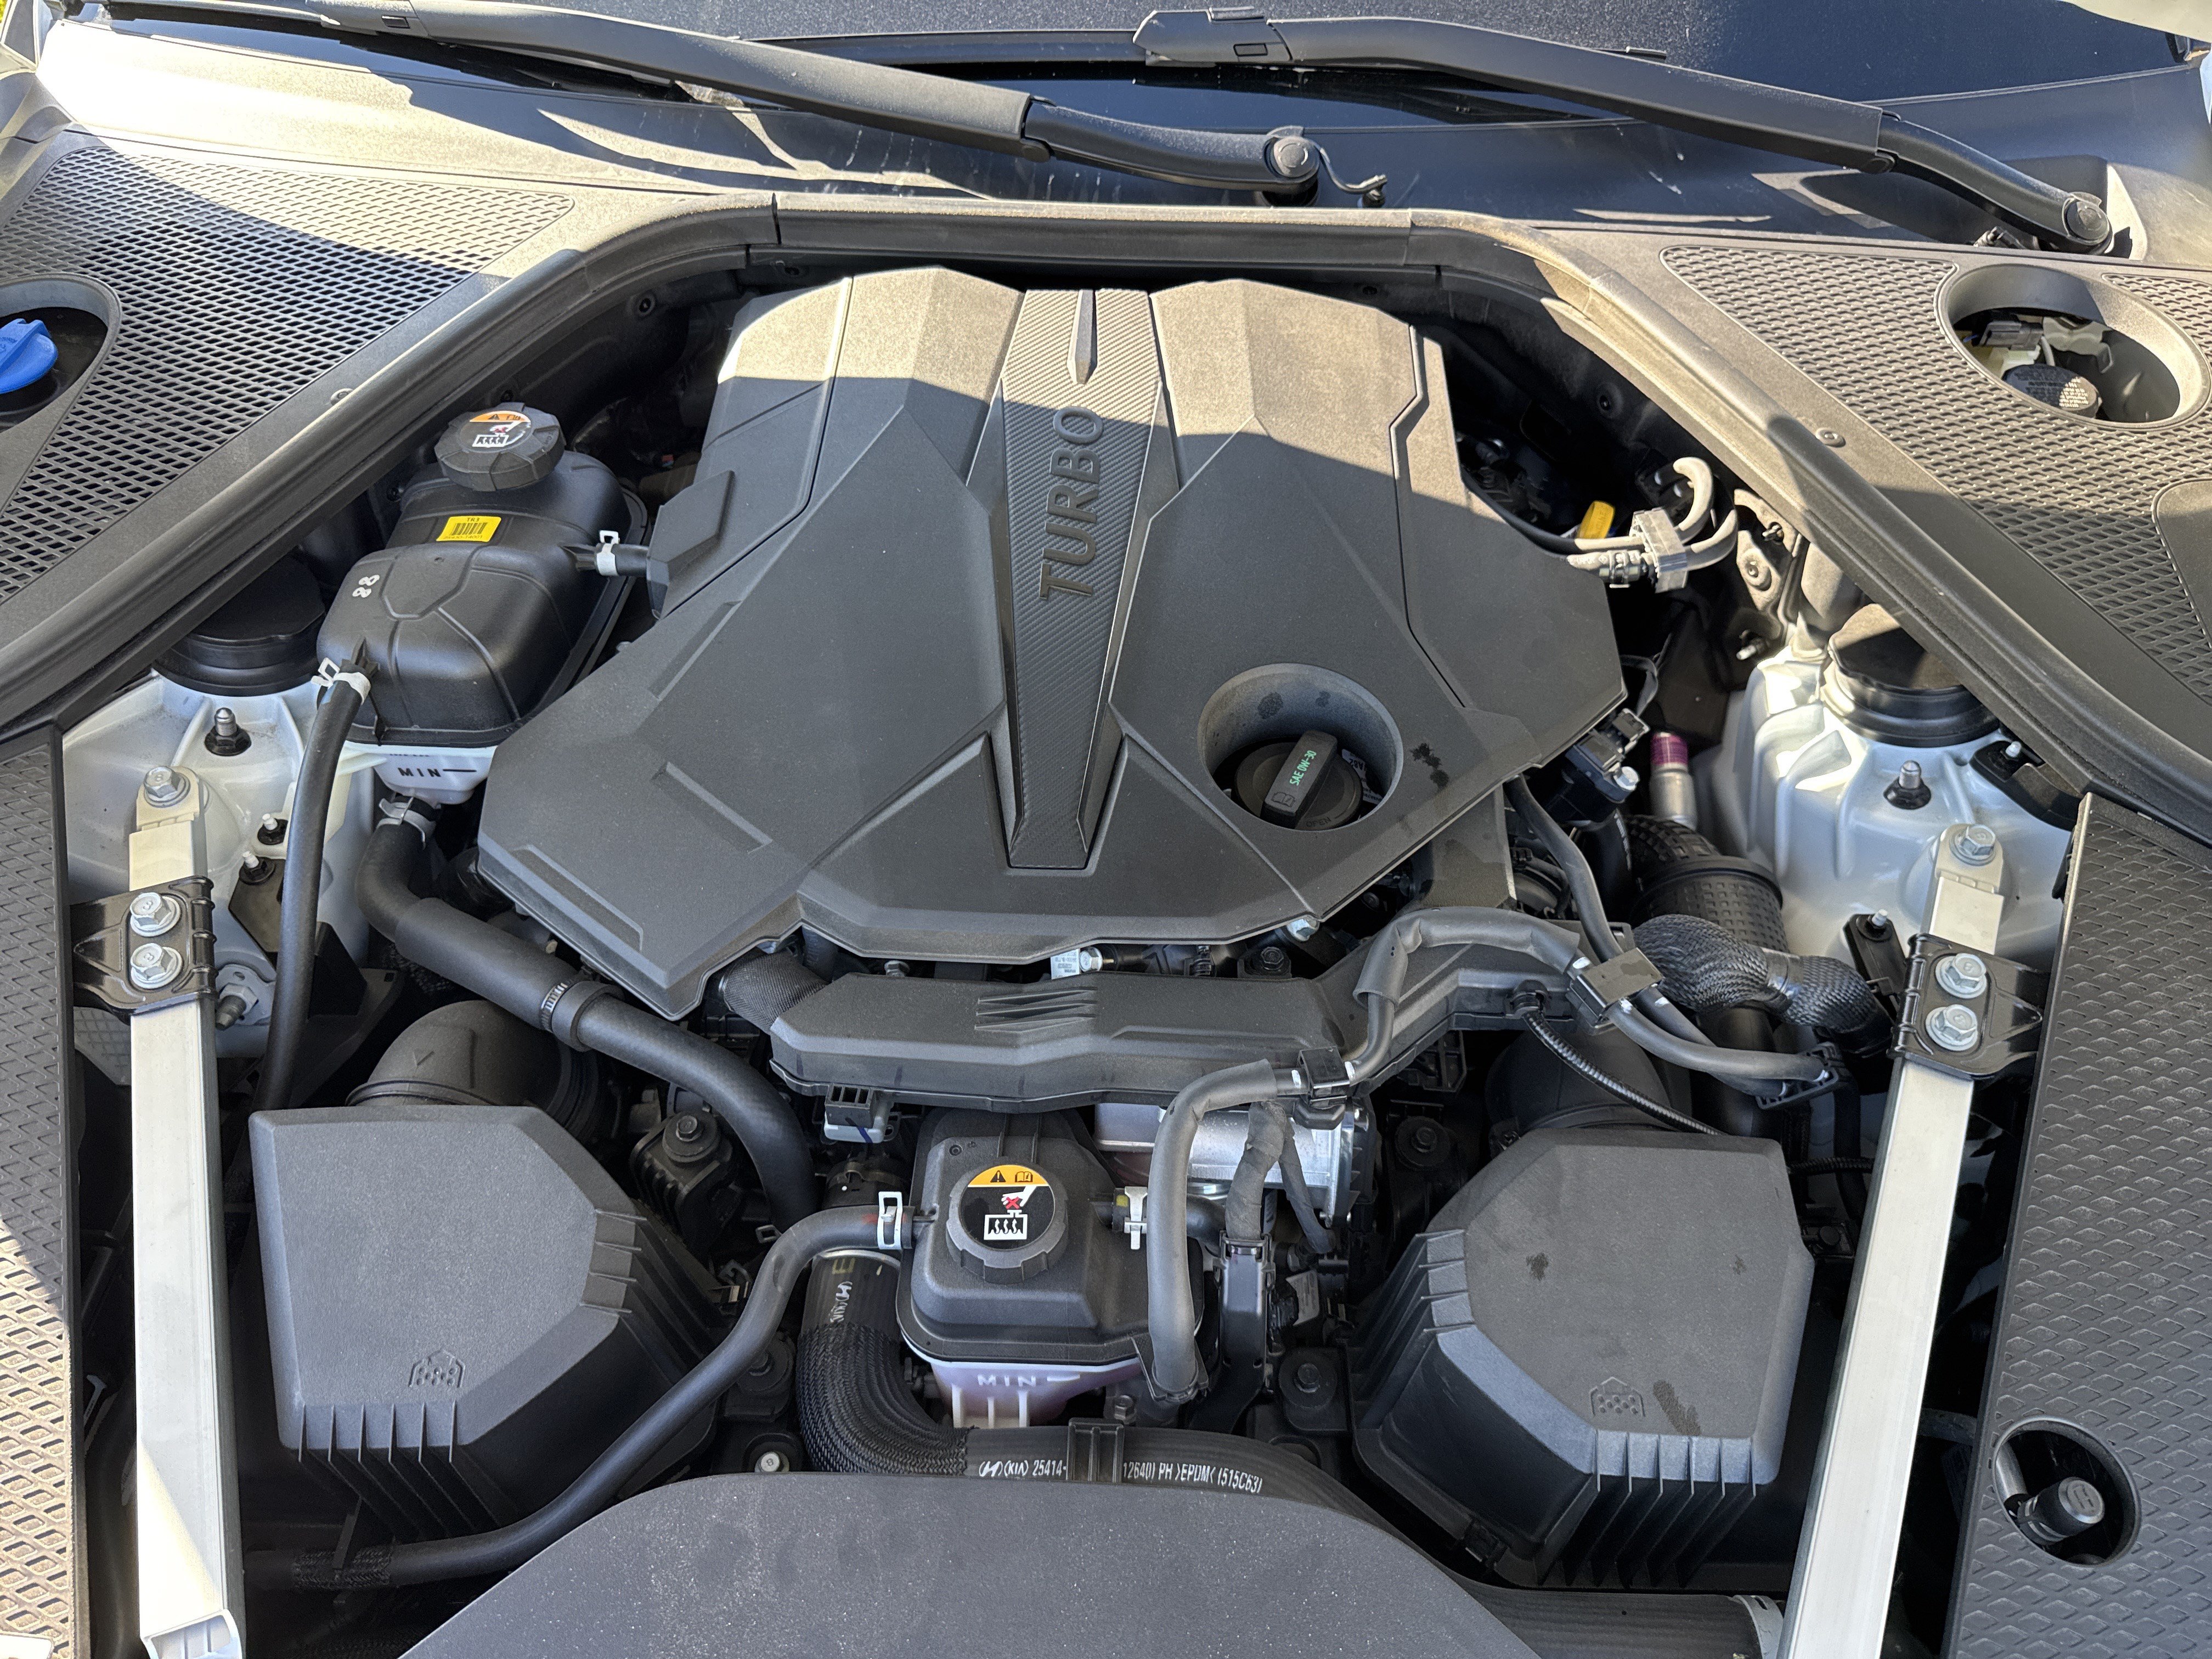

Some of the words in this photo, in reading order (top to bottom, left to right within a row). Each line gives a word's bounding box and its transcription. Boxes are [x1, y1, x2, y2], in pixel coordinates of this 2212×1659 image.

[1040, 406, 1103, 601] TURBO
[398, 767, 442, 777] MIN
[1289, 770, 1304, 786] SAE
[1297, 749, 1317, 772] 0W-30
[1306, 816, 1331, 828] OPEN
[977, 1373, 1036, 1387] MIN
[1032, 1459, 1066, 1476] 25414-
[1158, 1462, 1173, 1480] PH
